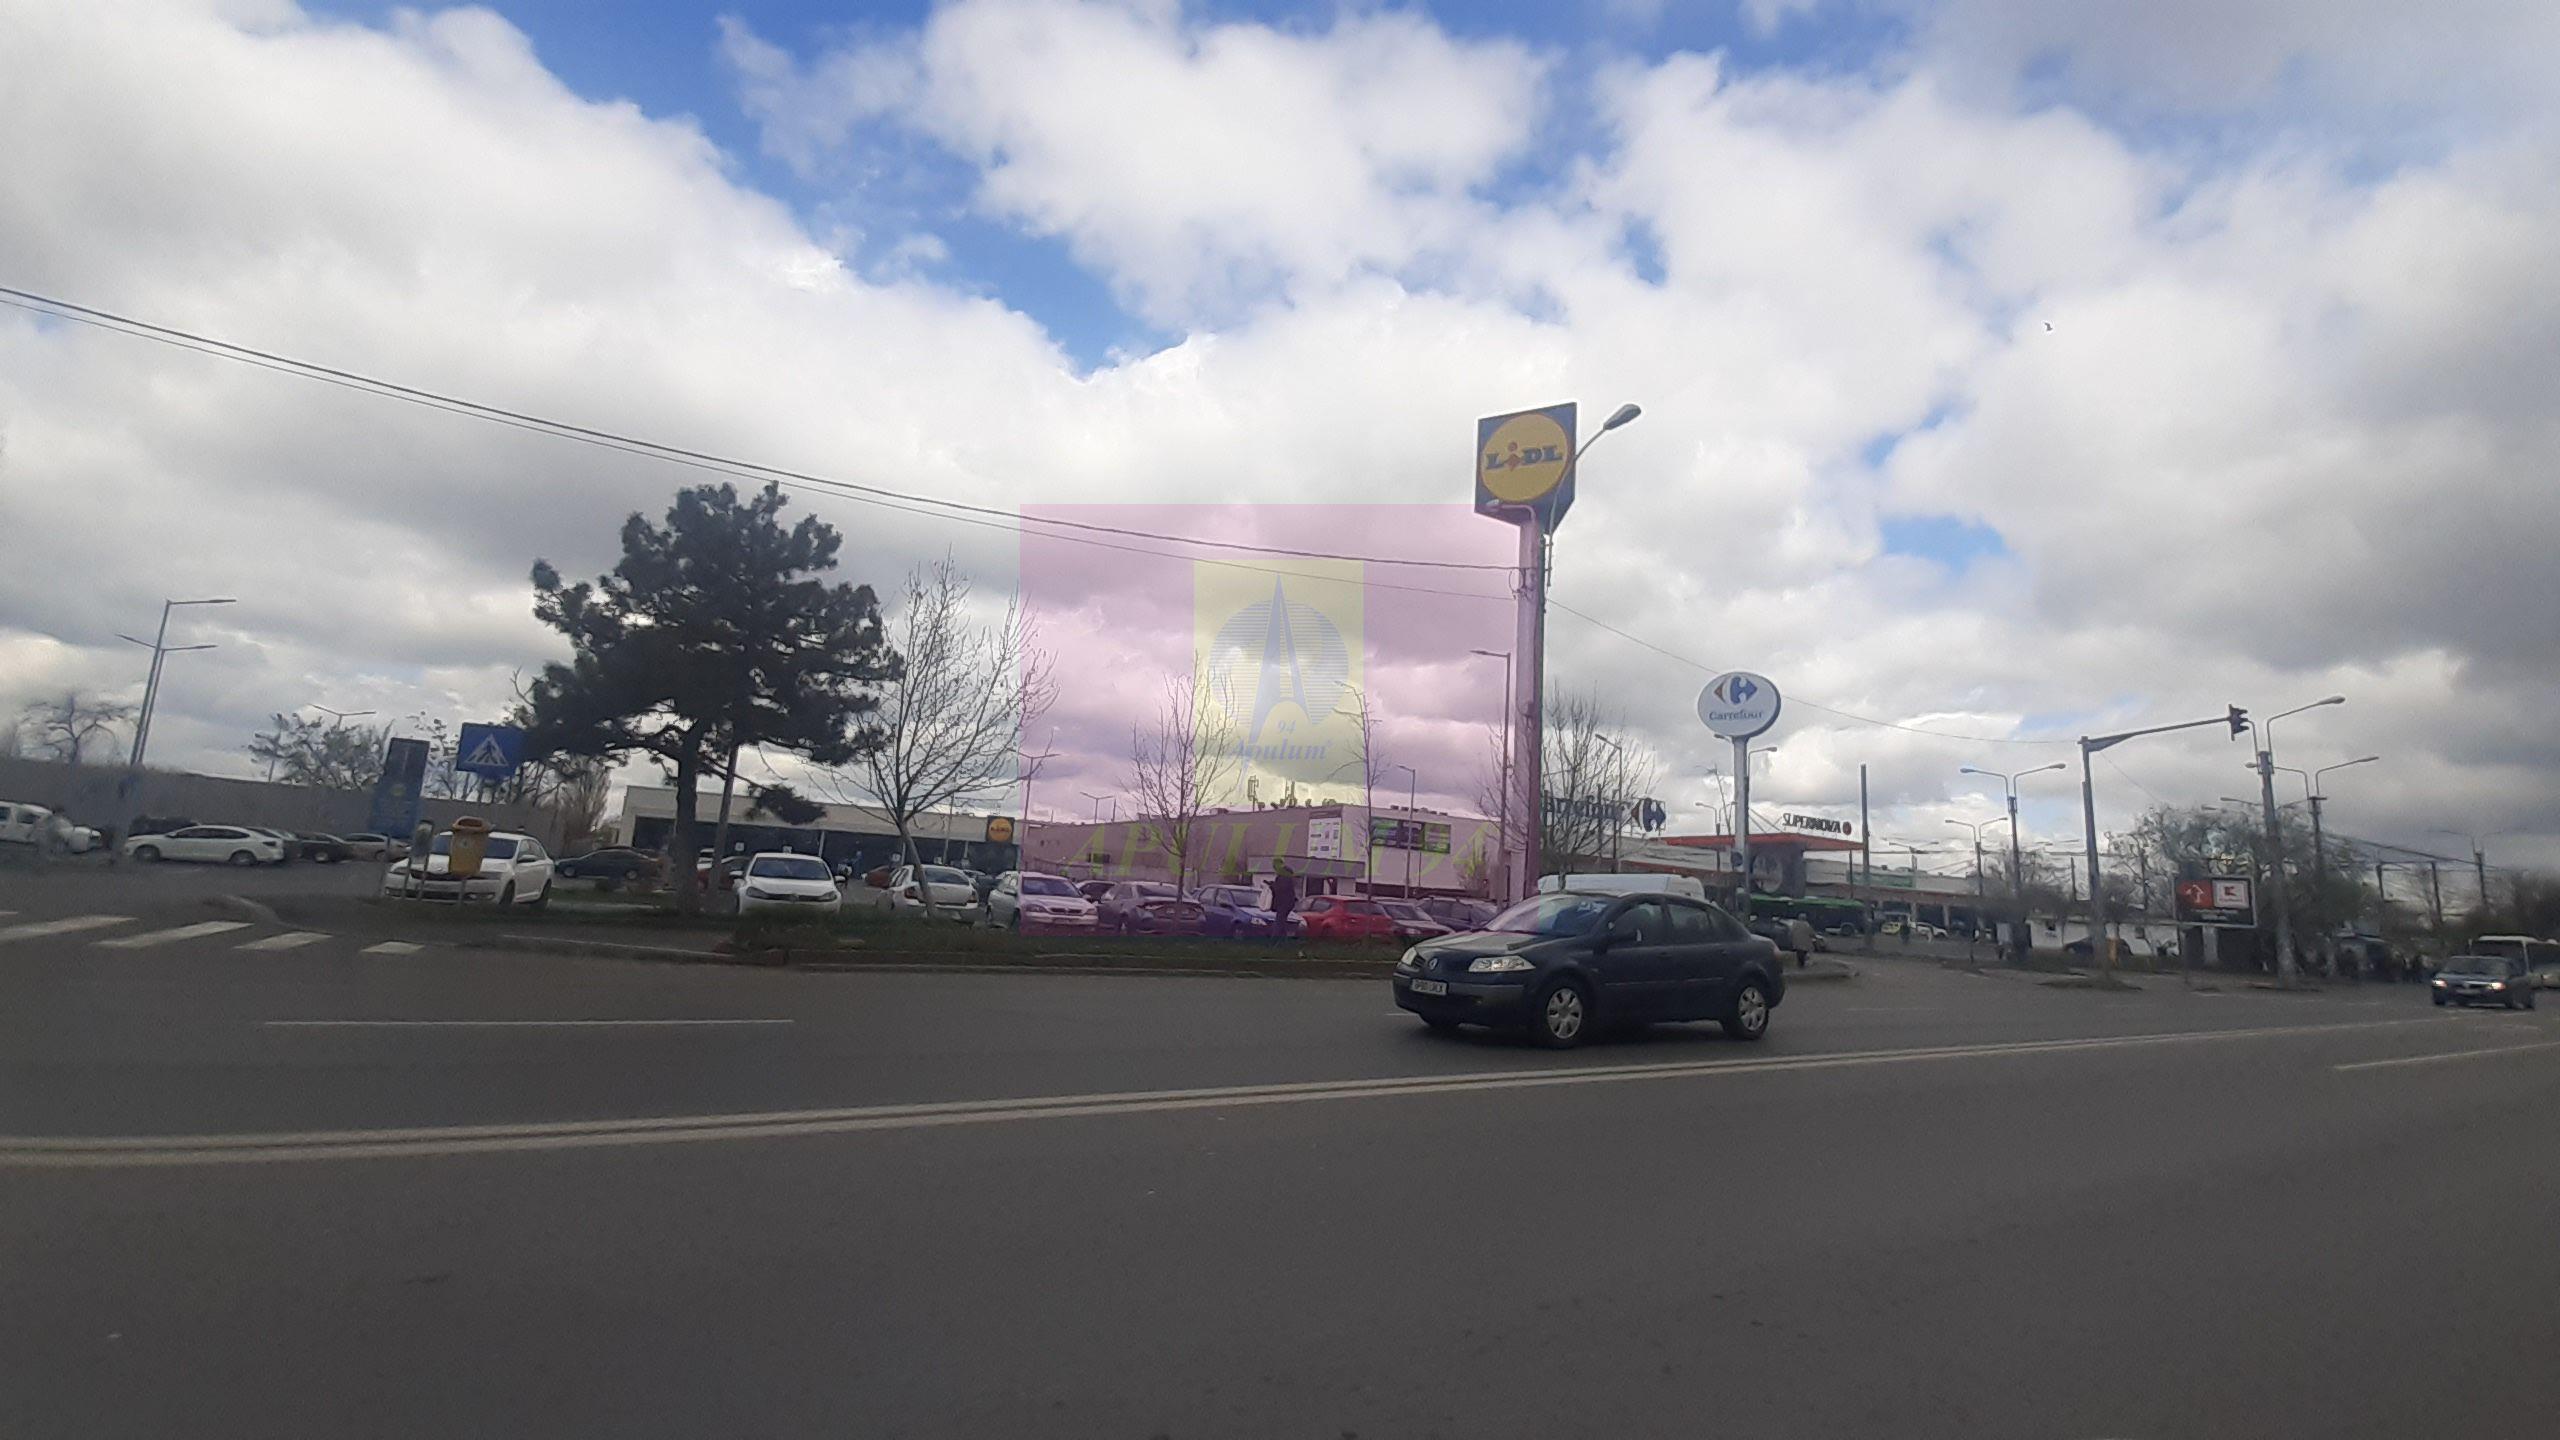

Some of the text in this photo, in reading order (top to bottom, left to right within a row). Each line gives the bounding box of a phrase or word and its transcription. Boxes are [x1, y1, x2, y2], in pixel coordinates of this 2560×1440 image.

[1486, 441, 1562, 470] LIDL
[1709, 709, 1763, 721] Carrefour
[1782, 812, 1841, 833] SUPERNOVA
